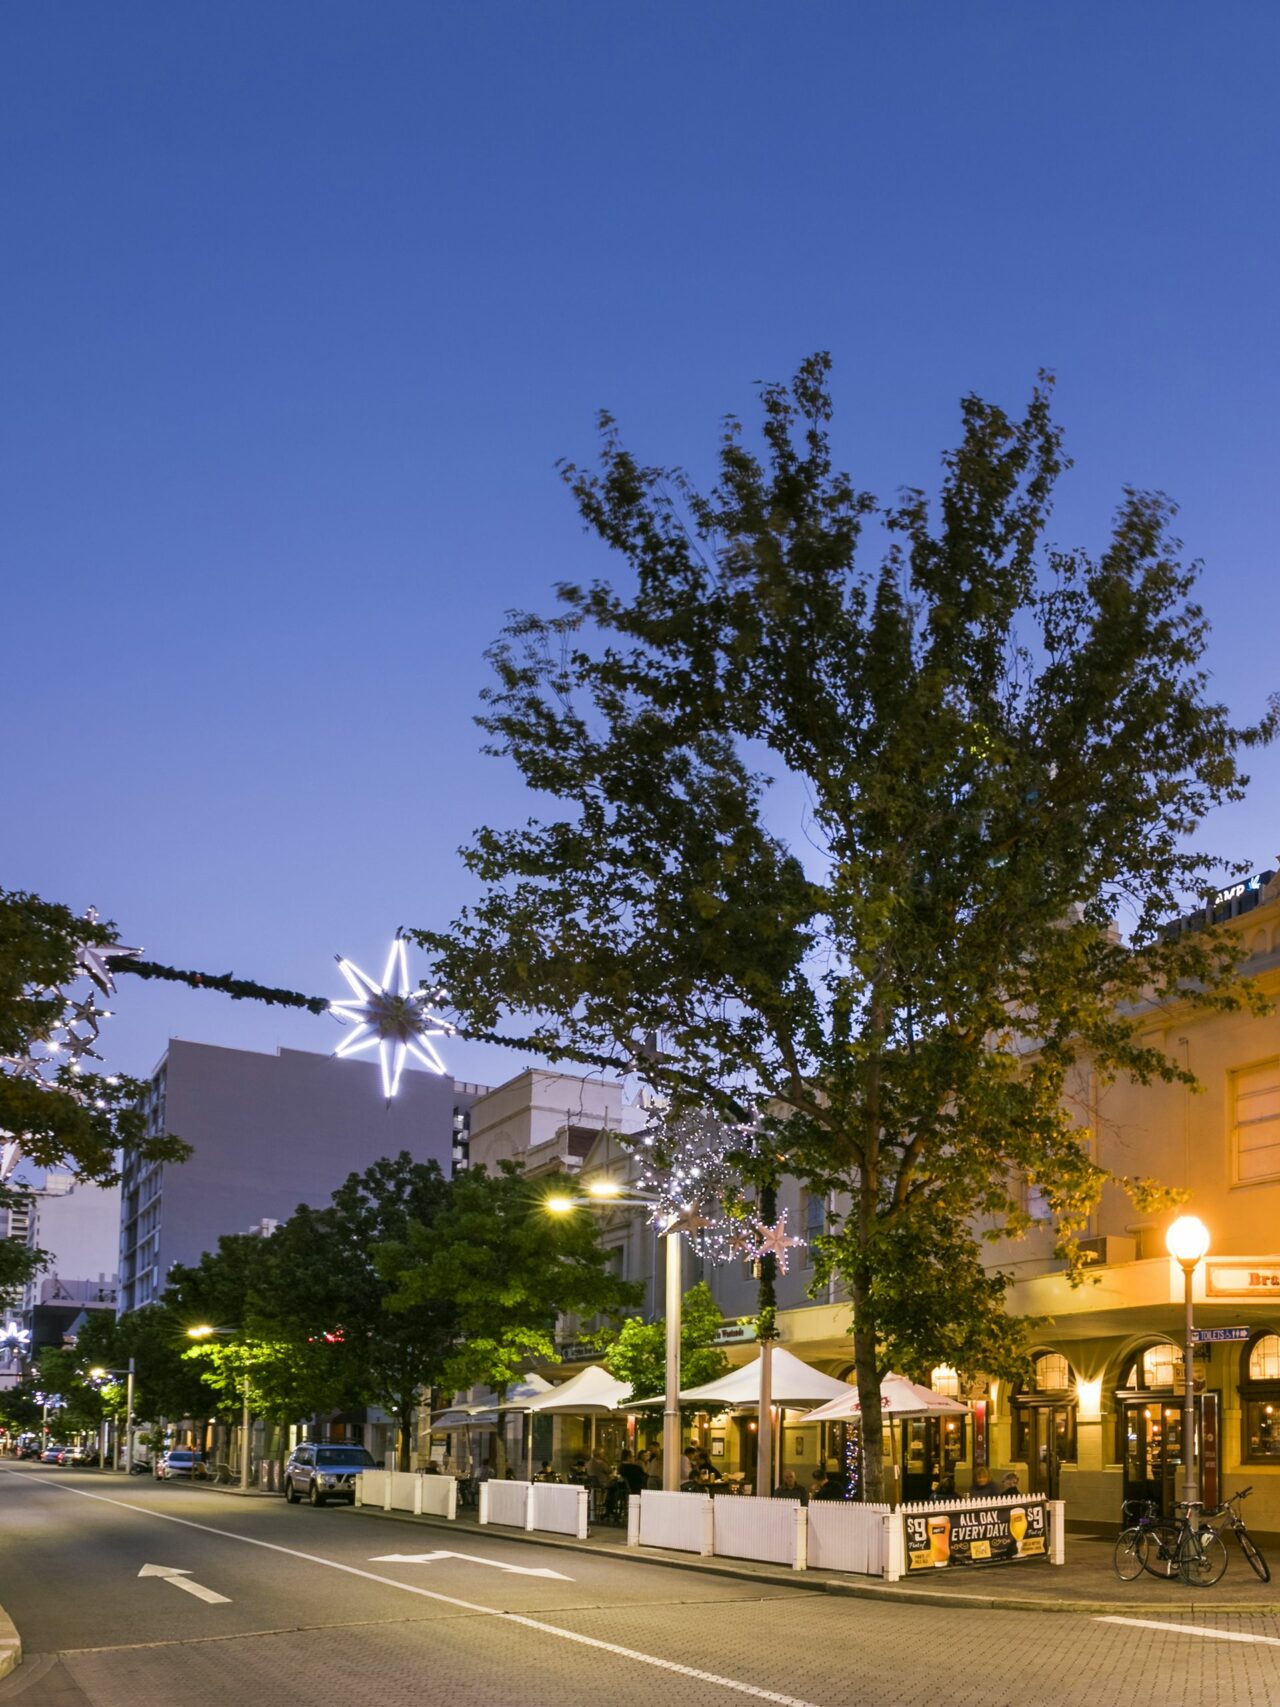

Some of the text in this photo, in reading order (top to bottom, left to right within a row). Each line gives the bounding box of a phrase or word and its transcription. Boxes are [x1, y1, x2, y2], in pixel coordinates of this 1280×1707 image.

[1214, 884, 1246, 907] AMP
[1200, 1330, 1225, 1340] TOILETS
[960, 1513, 978, 1527] ALL
[1027, 1506, 1044, 1529] $9
[906, 1516, 927, 1541] $9
[951, 1525, 986, 1541] EVERY
[986, 1522, 1009, 1538] DAY!
